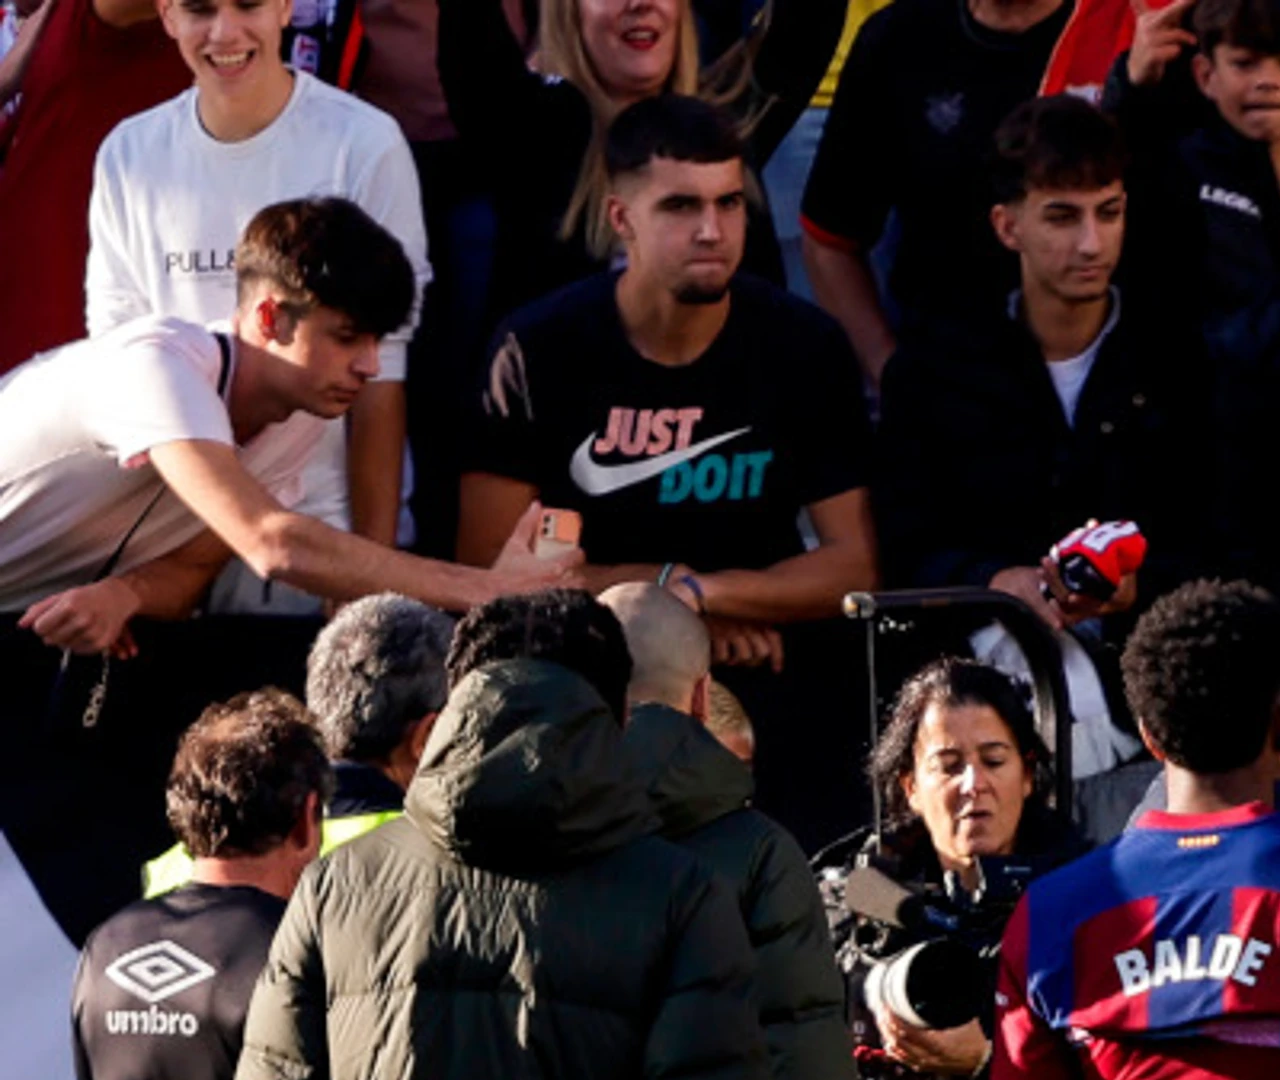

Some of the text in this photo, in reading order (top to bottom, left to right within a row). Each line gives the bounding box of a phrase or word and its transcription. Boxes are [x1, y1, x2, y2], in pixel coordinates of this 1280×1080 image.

[594, 406, 704, 456] JUST
[1114, 933, 1272, 997] BALDE
[105, 1004, 199, 1036] umbro
